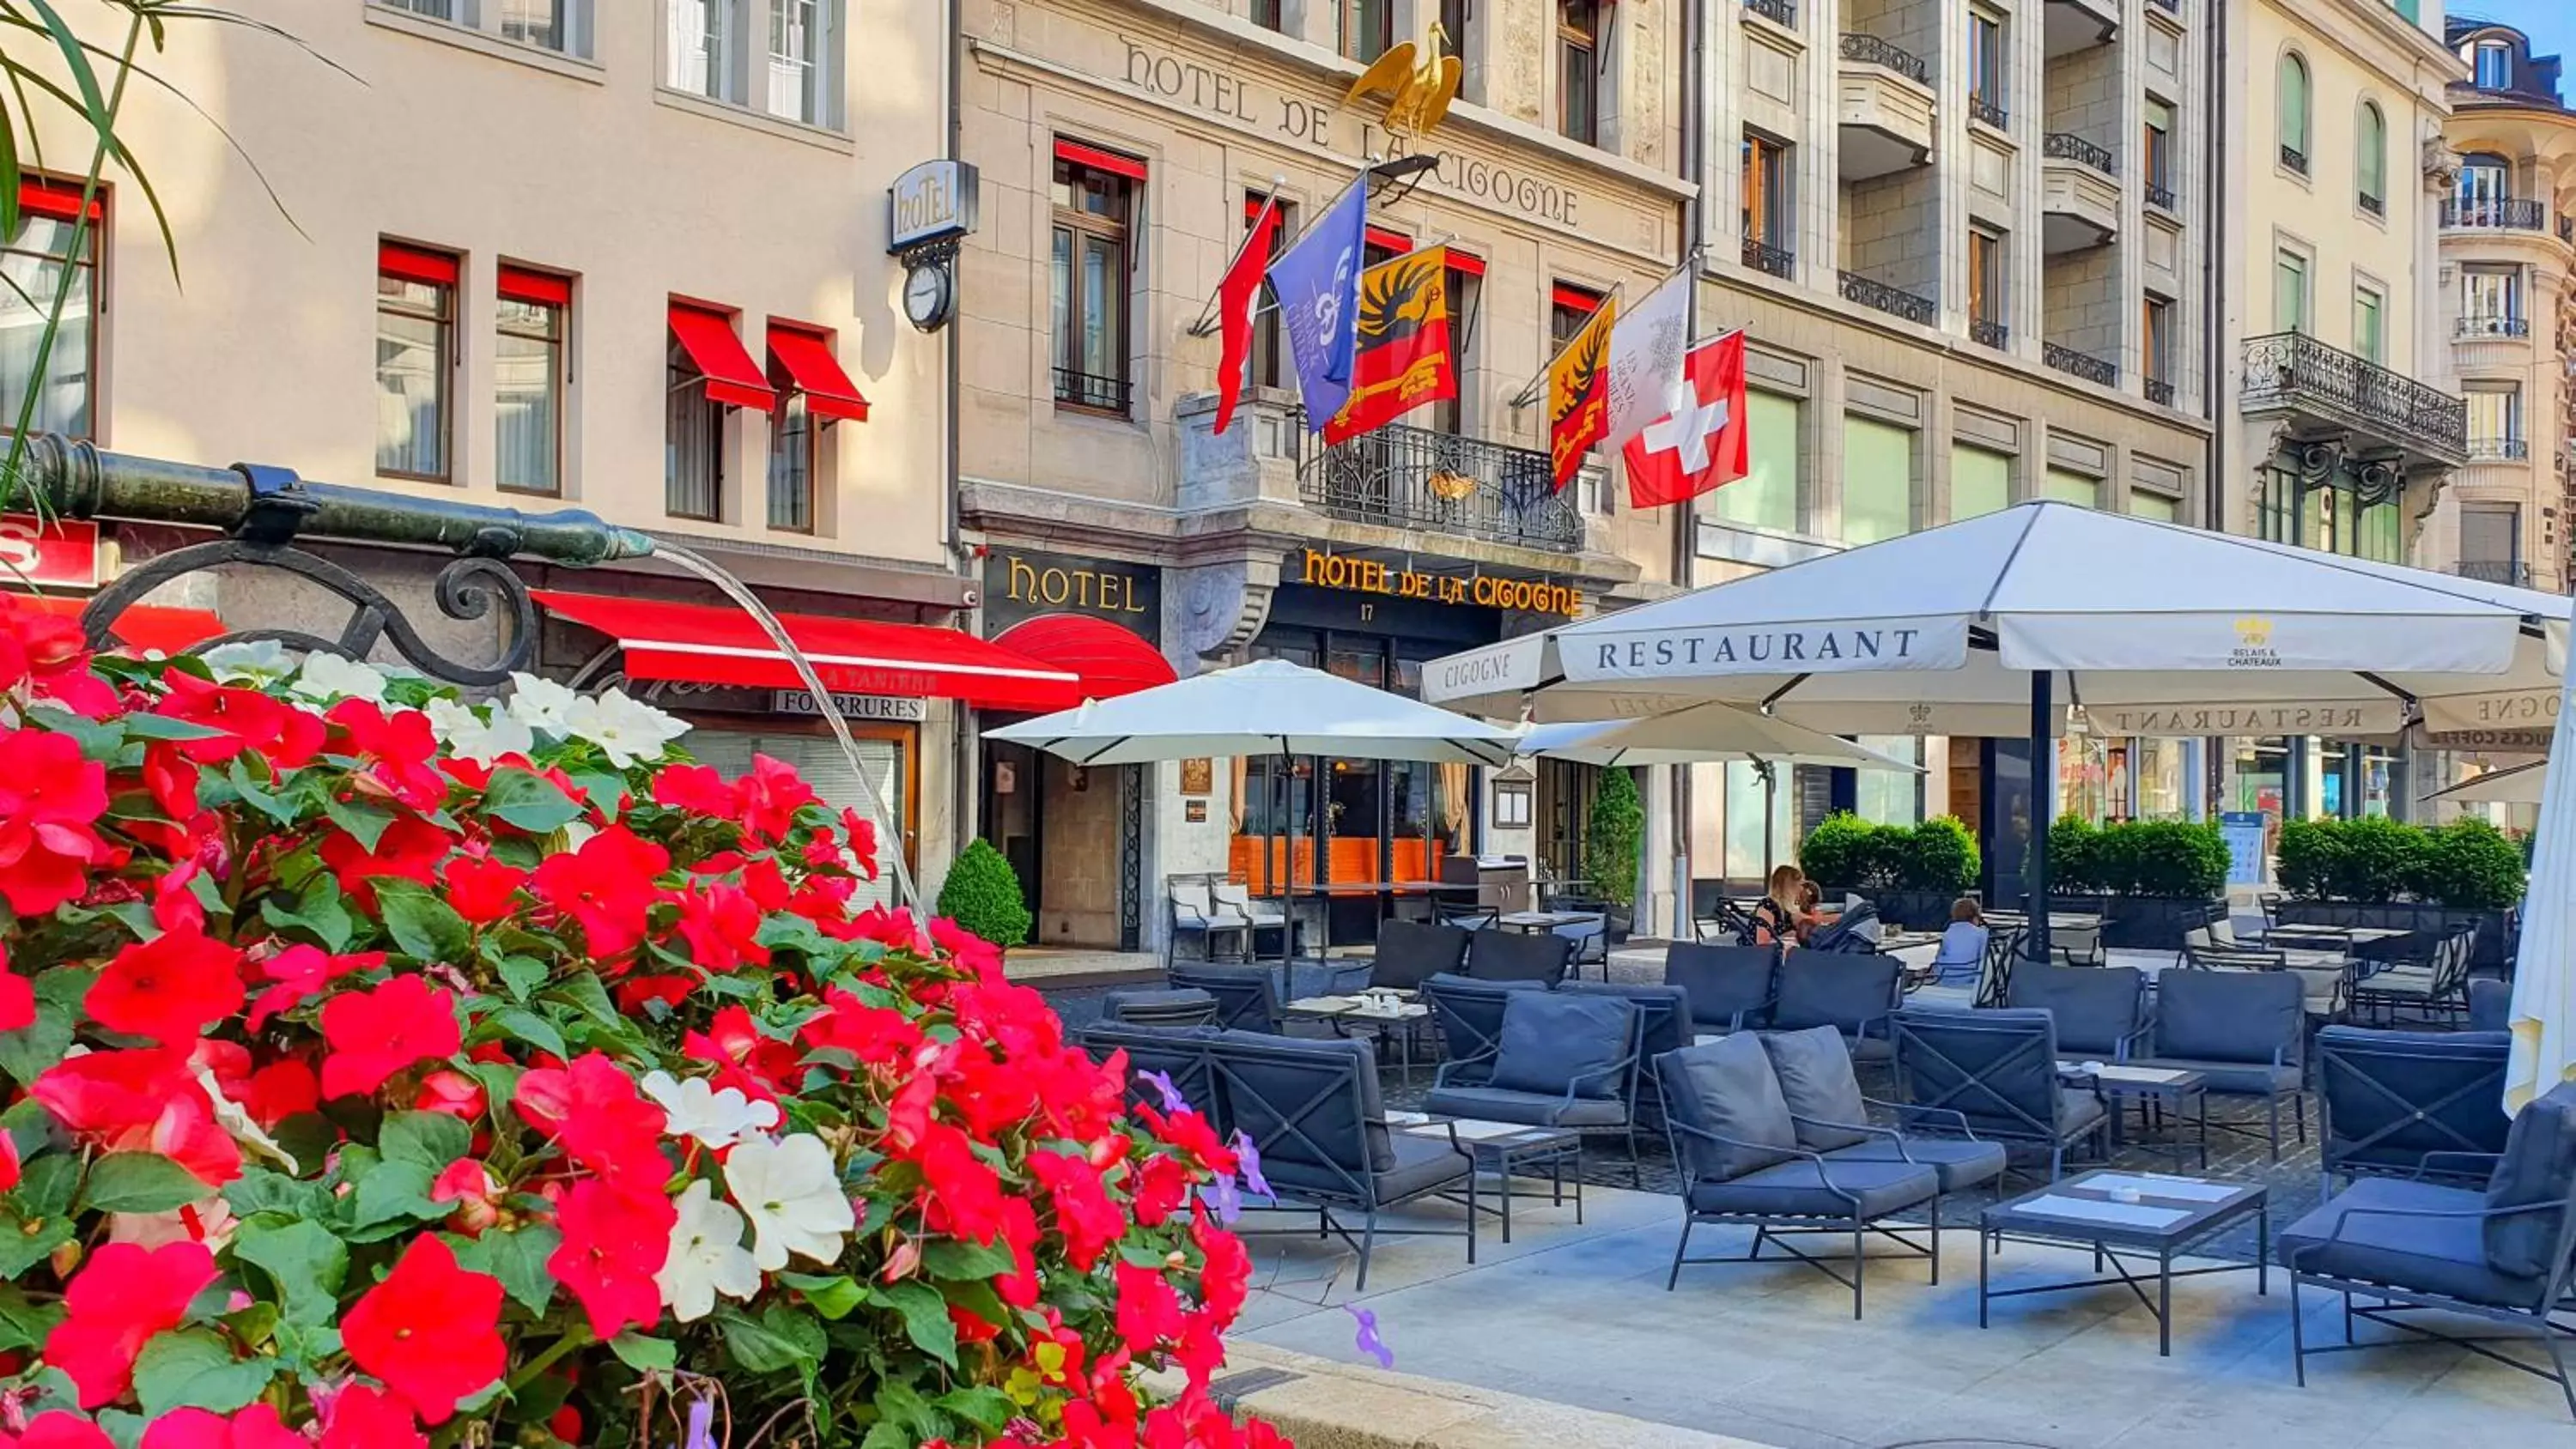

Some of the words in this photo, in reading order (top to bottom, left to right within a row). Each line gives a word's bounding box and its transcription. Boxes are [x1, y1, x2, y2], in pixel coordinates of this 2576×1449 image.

[1279, 97, 1328, 146] DE
[1435, 150, 1577, 227] CIGOGNE
[1400, 570, 1431, 597] DE
[1438, 576, 1465, 604] LA
[1474, 576, 1583, 617] CIGOGNE
[1361, 603, 1373, 621] 17
[1598, 629, 1918, 669] RESTAURANT
[2227, 657, 2281, 667] CHATEAUX
[1444, 653, 1510, 688] CIGOGNE
[784, 692, 919, 718] FORRURES
